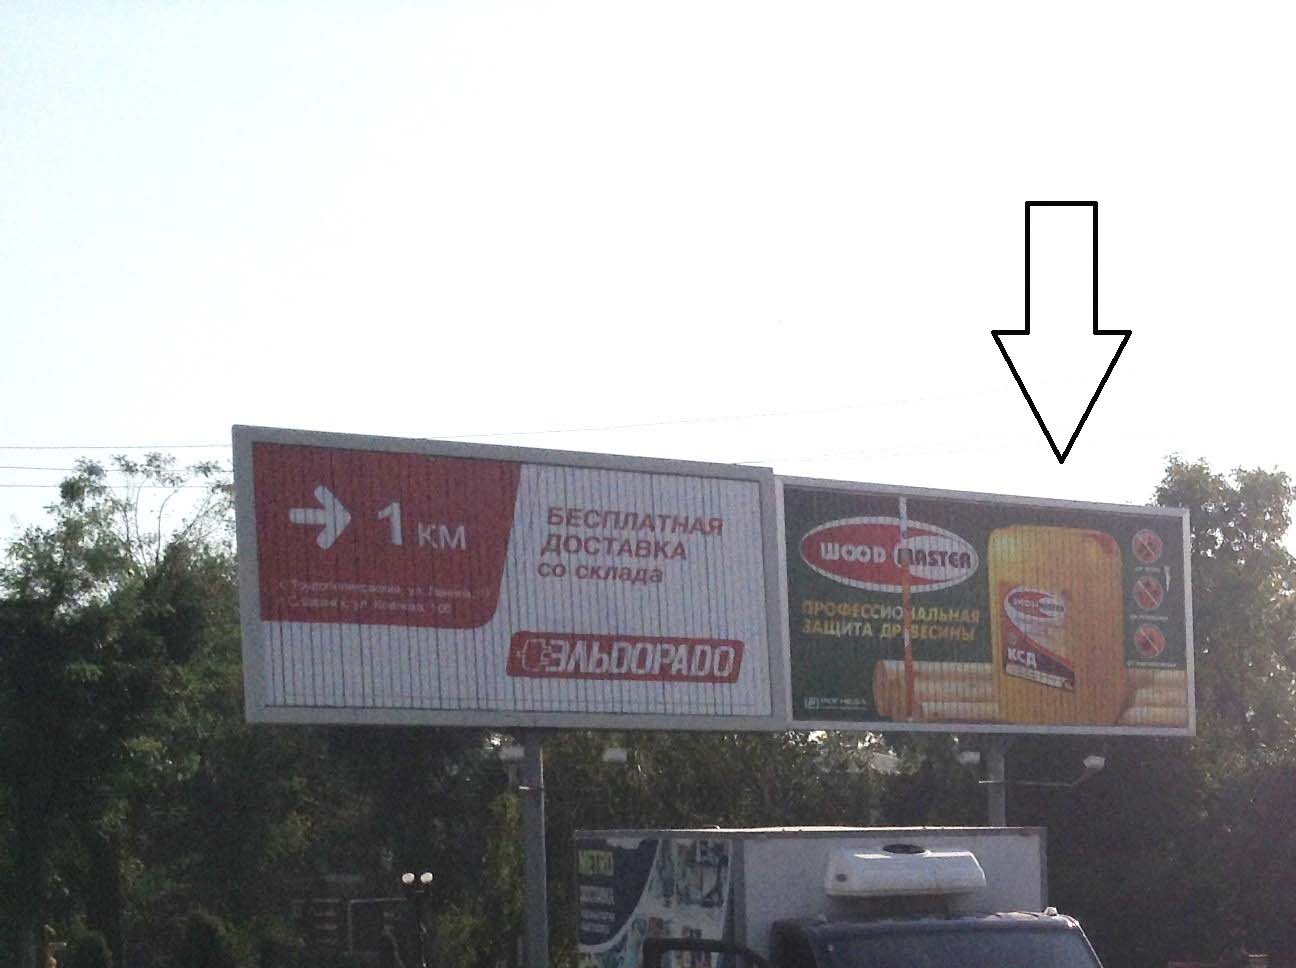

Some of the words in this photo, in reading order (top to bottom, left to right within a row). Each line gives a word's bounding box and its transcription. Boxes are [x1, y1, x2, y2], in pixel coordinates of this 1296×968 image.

[378, 502, 403, 546] 1
[547, 506, 724, 536] БЕСПЛАТНАЯ
[540, 533, 687, 560] ДОСТАВКА
[820, 542, 887, 564] WOOD
[537, 562, 567, 578] со
[575, 564, 664, 586] склада
[802, 617, 873, 639] ЗАЩИТА
[879, 622, 977, 642] ДРВЕСИНЫ
